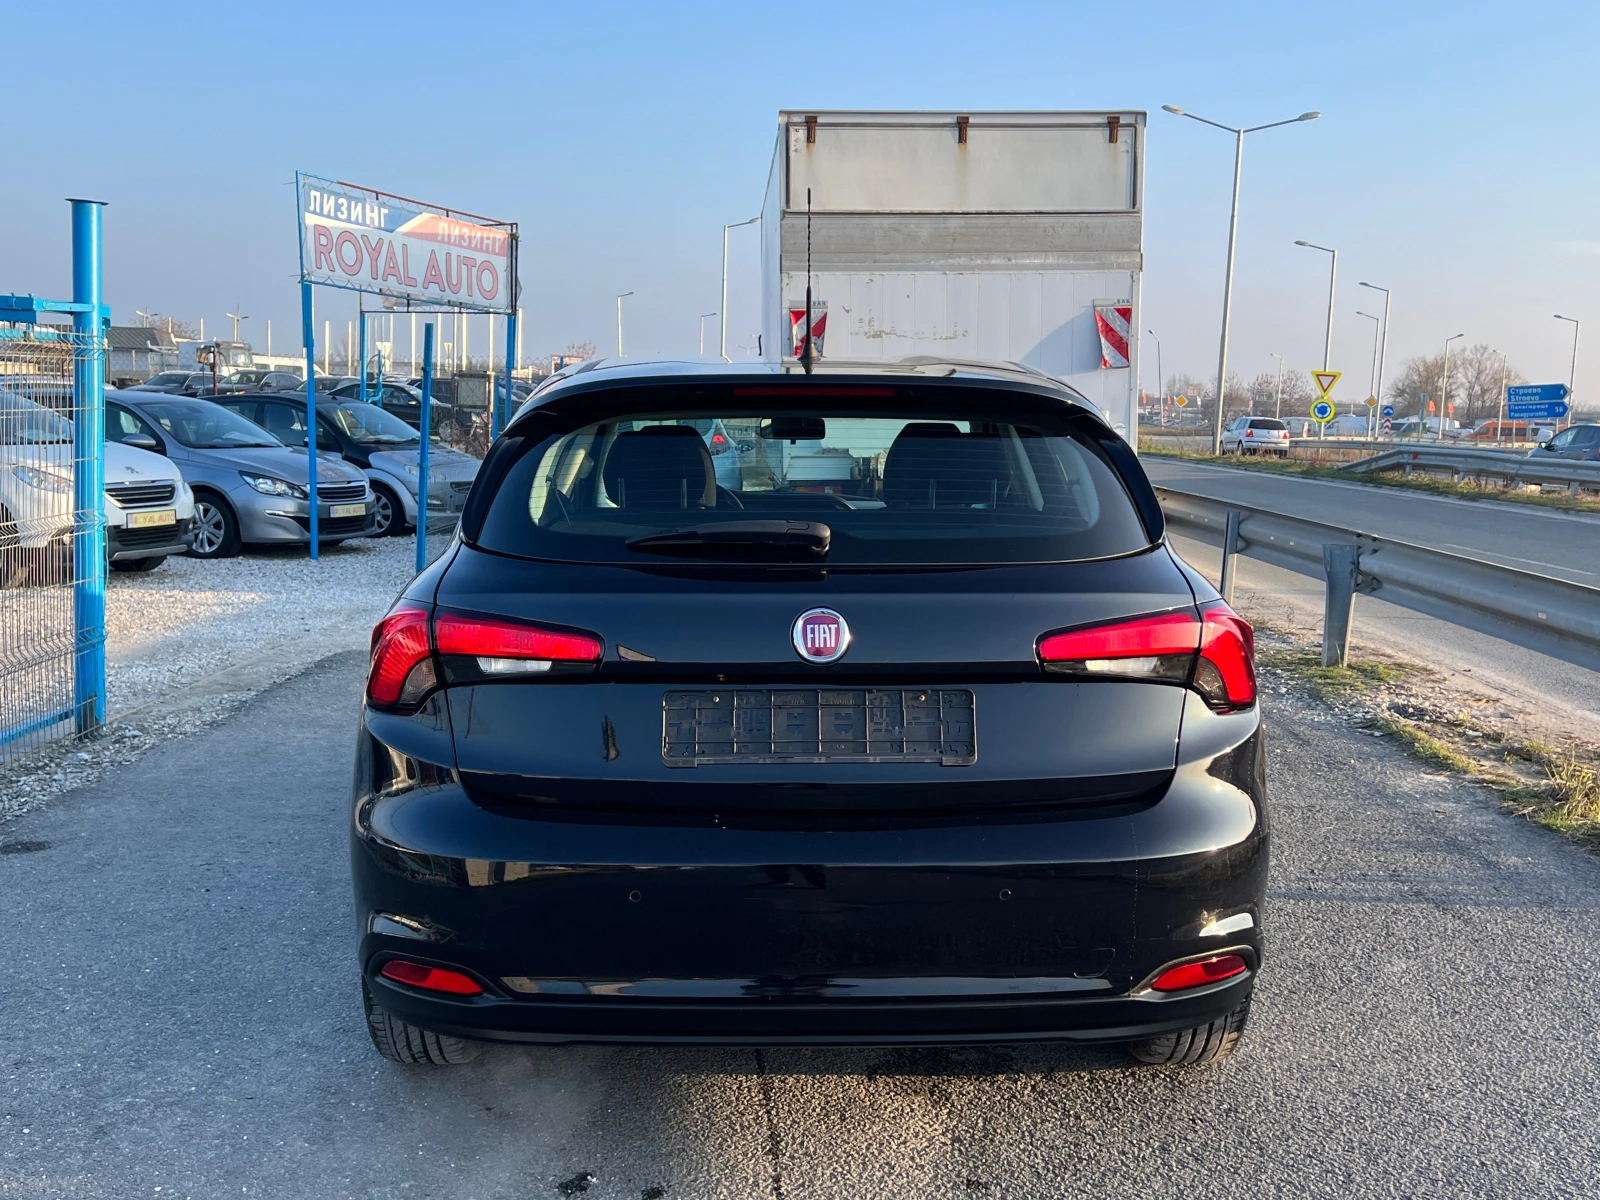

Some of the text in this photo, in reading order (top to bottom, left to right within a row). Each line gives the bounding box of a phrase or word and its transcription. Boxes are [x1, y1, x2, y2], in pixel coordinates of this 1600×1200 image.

[308, 189, 389, 229] ЛИЗИНГ
[437, 221, 505, 253] ЛИЗИНГ
[313, 223, 499, 301] ROYAL AUTO
[1510, 387, 1542, 395] Строево
[157, 512, 175, 523] AUTO
[806, 624, 838, 648] FIAT
